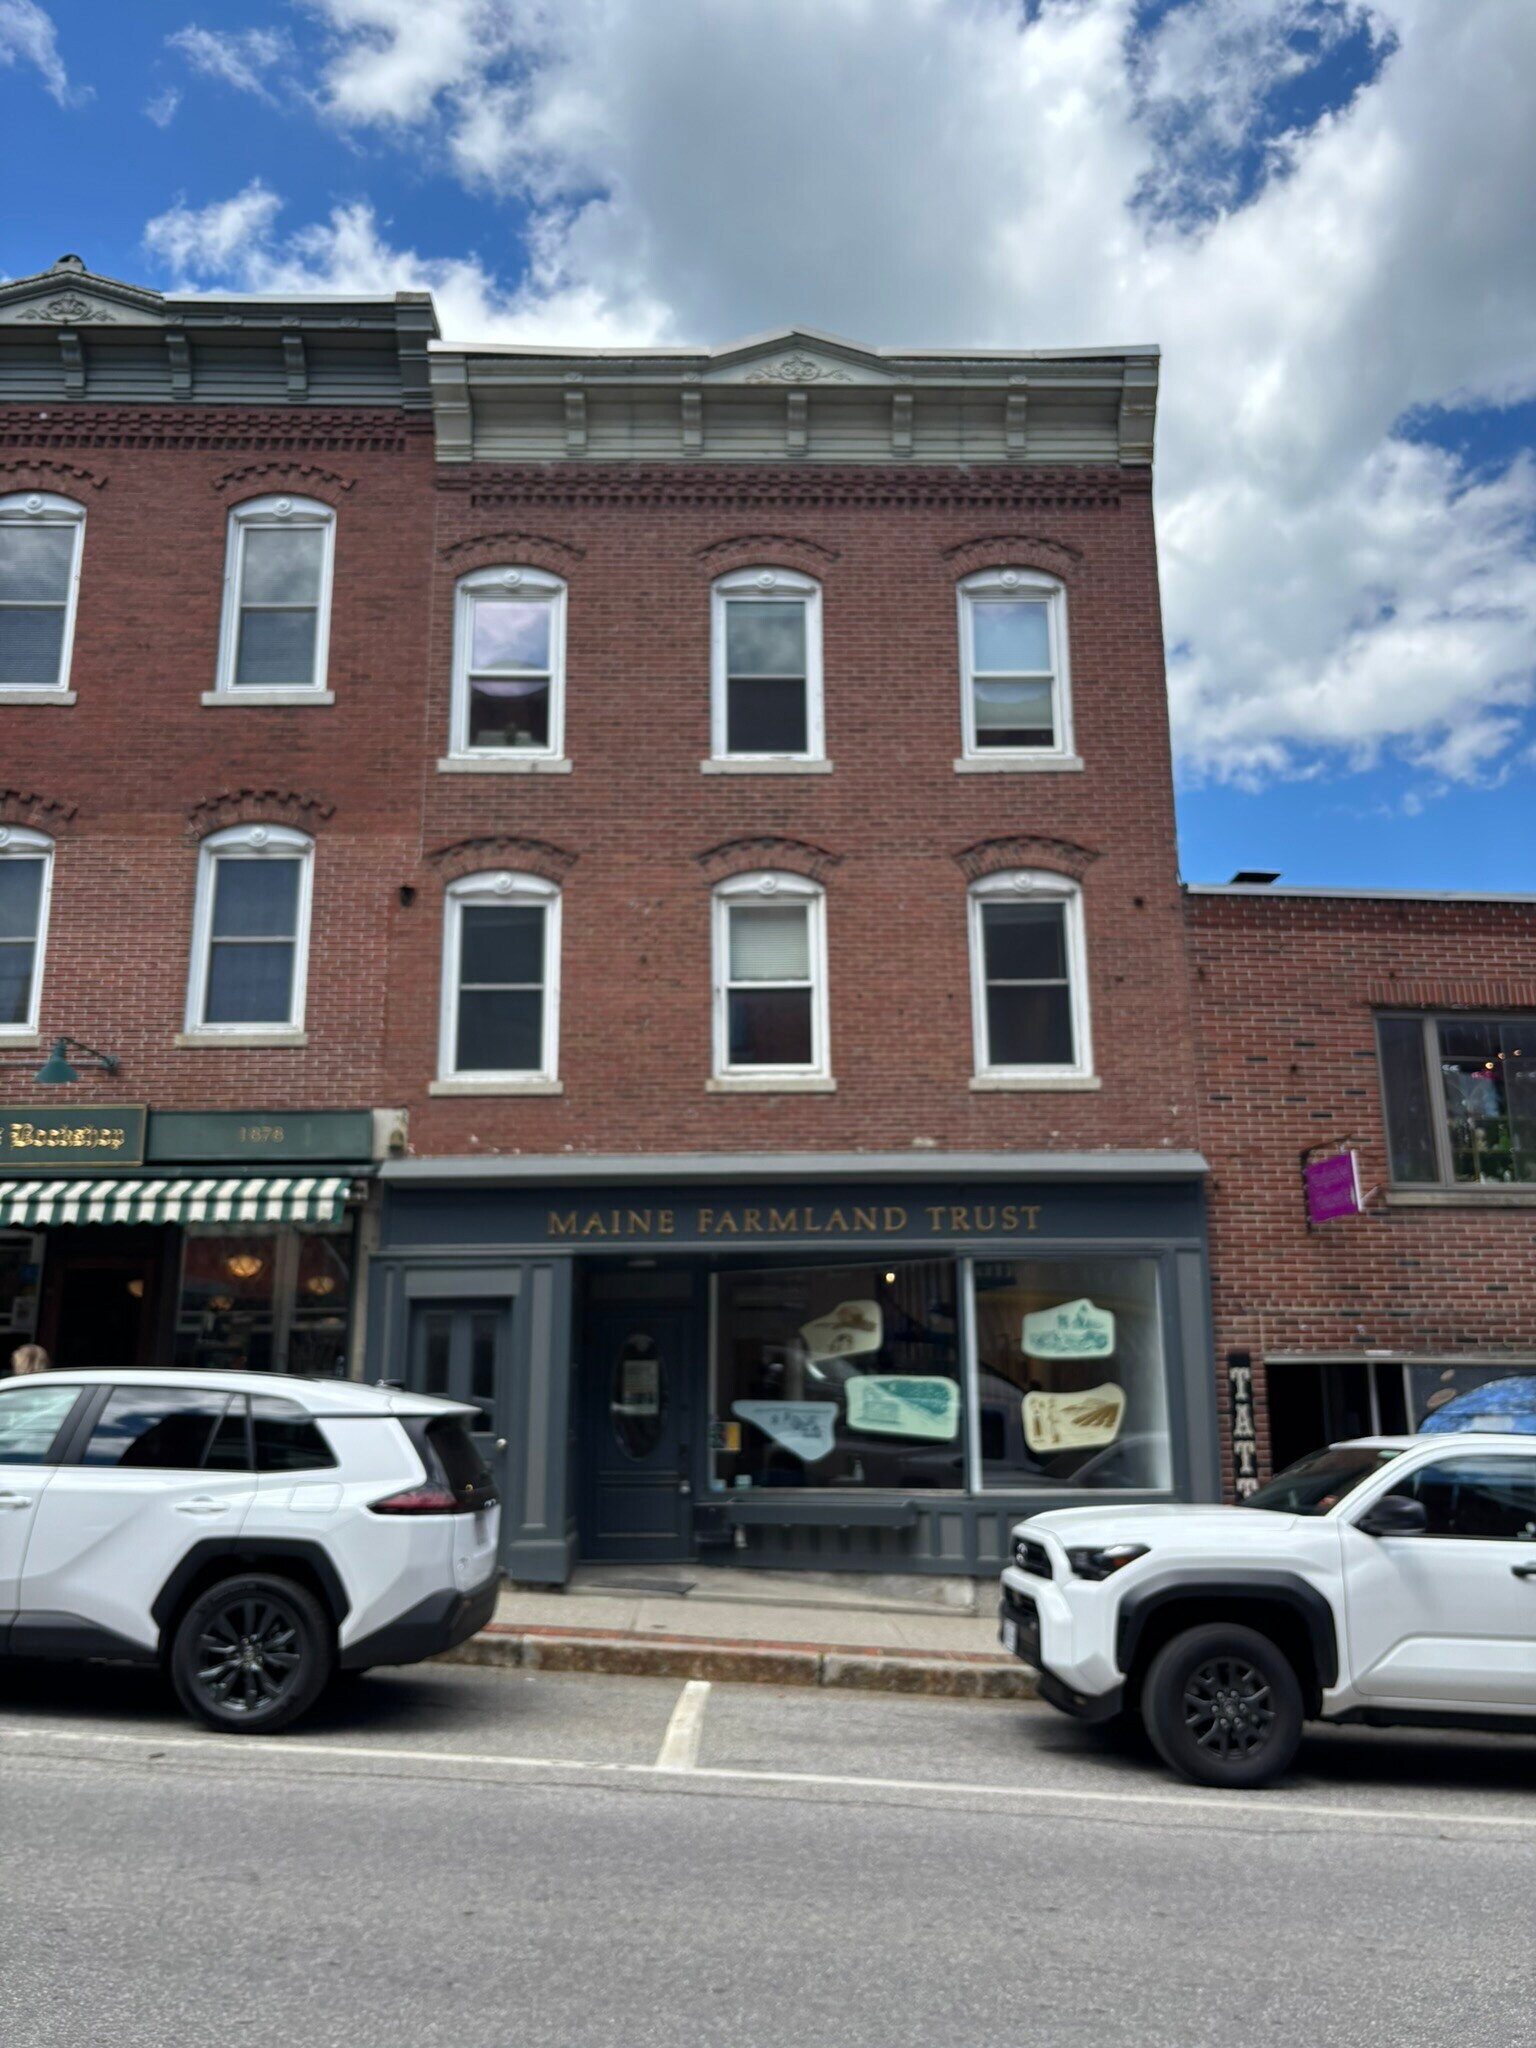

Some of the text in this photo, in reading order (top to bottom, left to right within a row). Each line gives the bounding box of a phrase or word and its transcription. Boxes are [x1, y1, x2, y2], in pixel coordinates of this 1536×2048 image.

[548, 1205, 1042, 1235] MAINE FARMLAND TRUST
